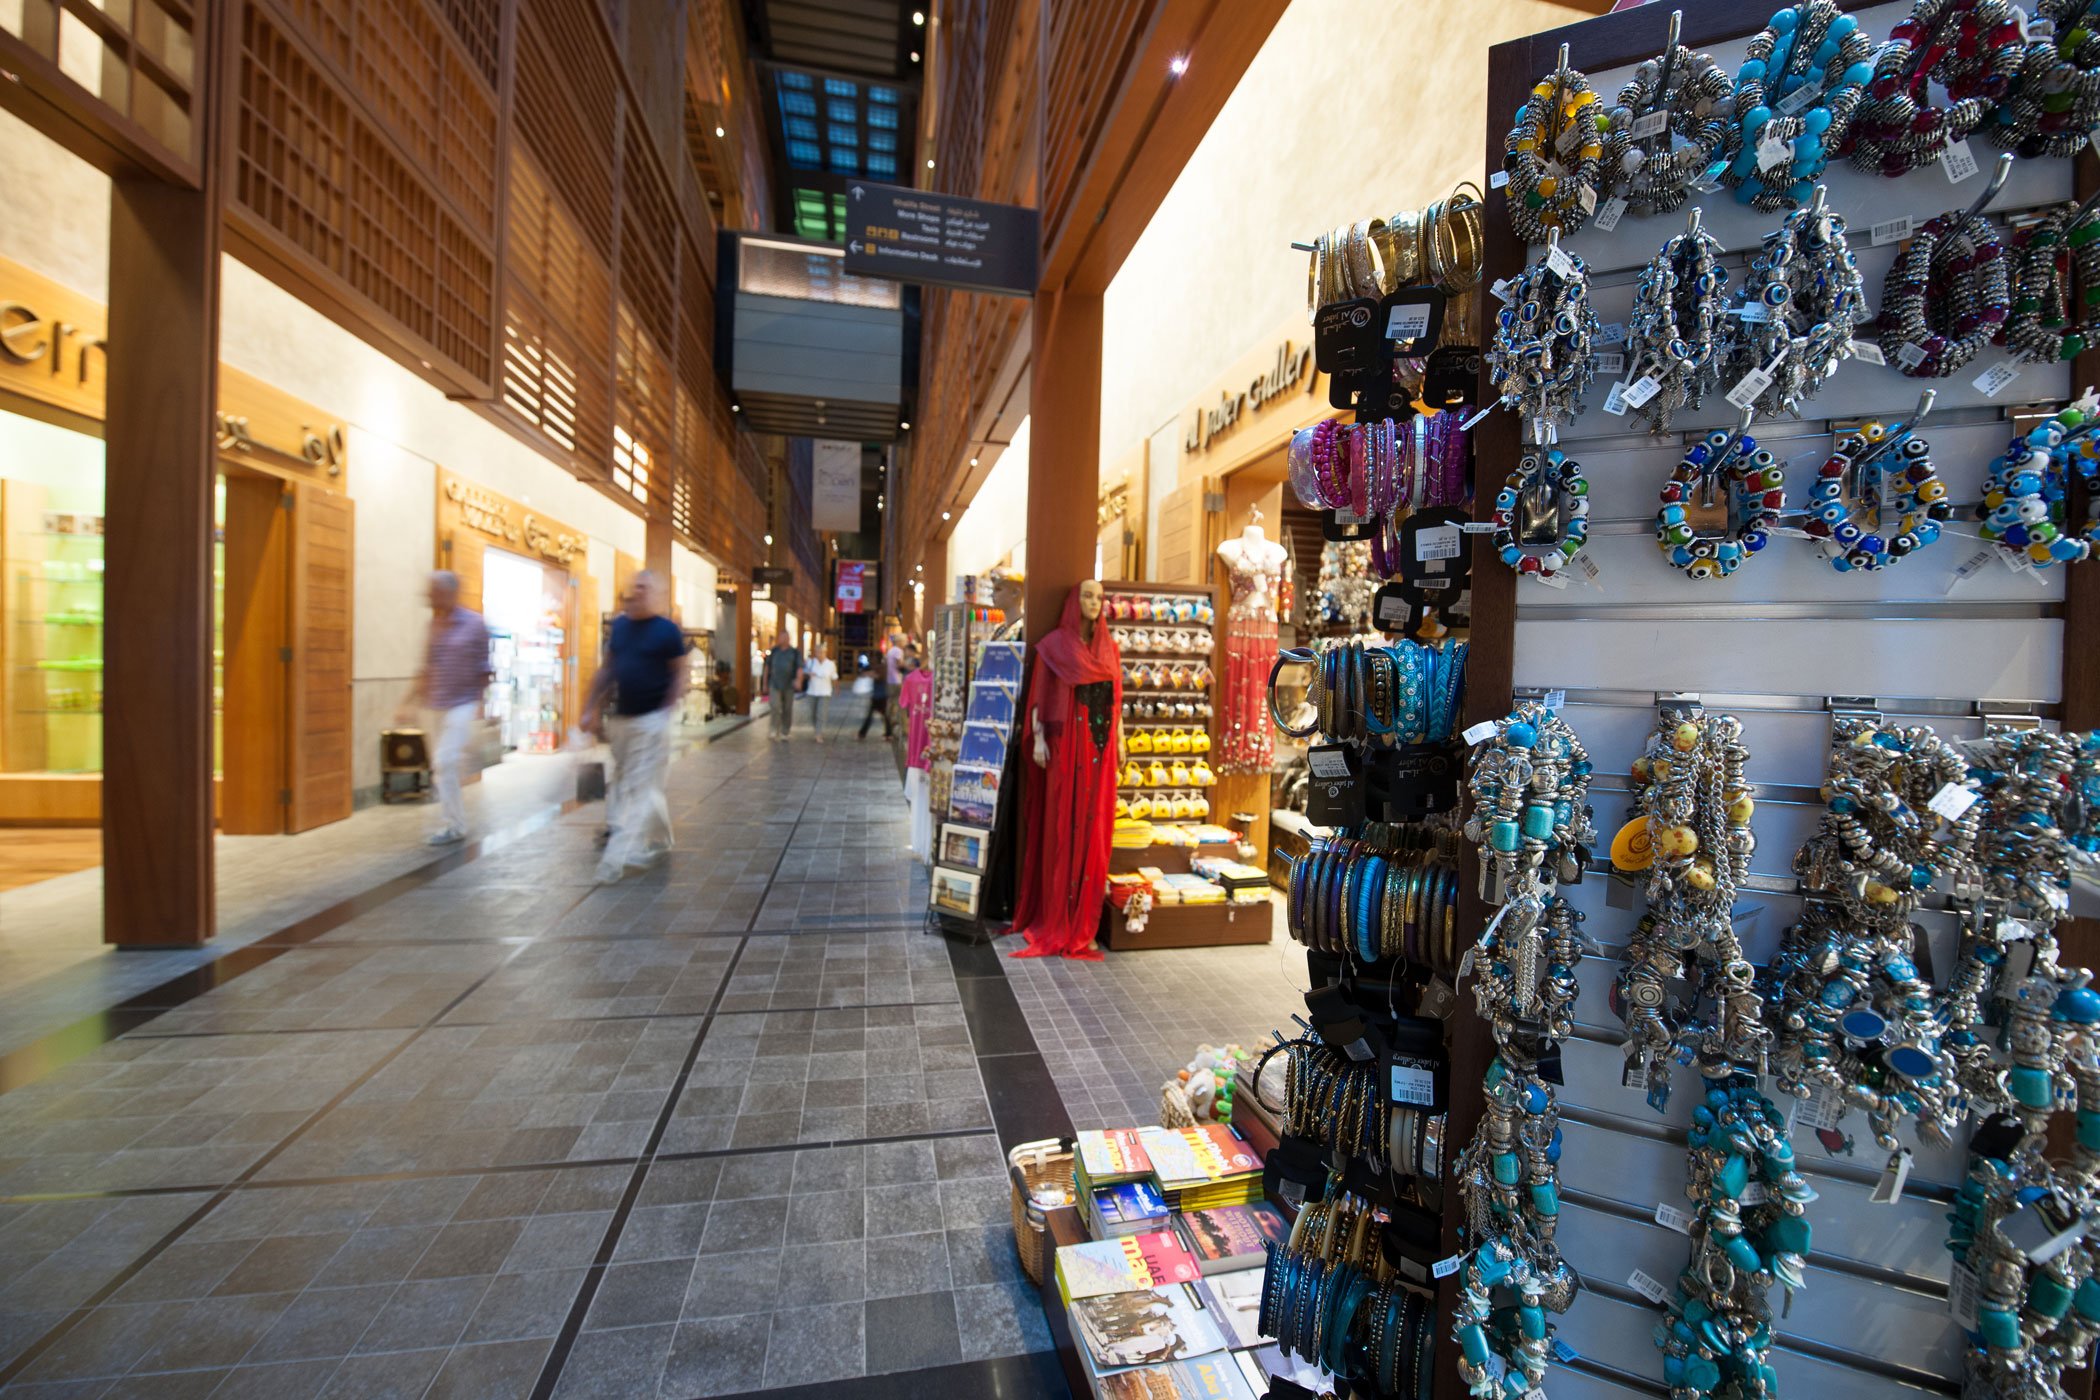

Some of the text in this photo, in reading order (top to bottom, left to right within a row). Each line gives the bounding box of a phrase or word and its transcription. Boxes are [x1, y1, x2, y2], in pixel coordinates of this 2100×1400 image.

[878, 246, 938, 260] Information Desk
[901, 232, 939, 244] Restrooms
[1104, 1138, 1125, 1171] map
[1184, 1132, 1222, 1179] map
[1194, 1128, 1233, 1171] Abu Dhabi
[1224, 1210, 1256, 1248] WITHOUT
[1233, 1211, 1261, 1243] MOTHER
[1119, 1235, 1154, 1289] map
[1144, 1254, 1166, 1285] UAE
[1196, 1364, 1220, 1395] Abu
